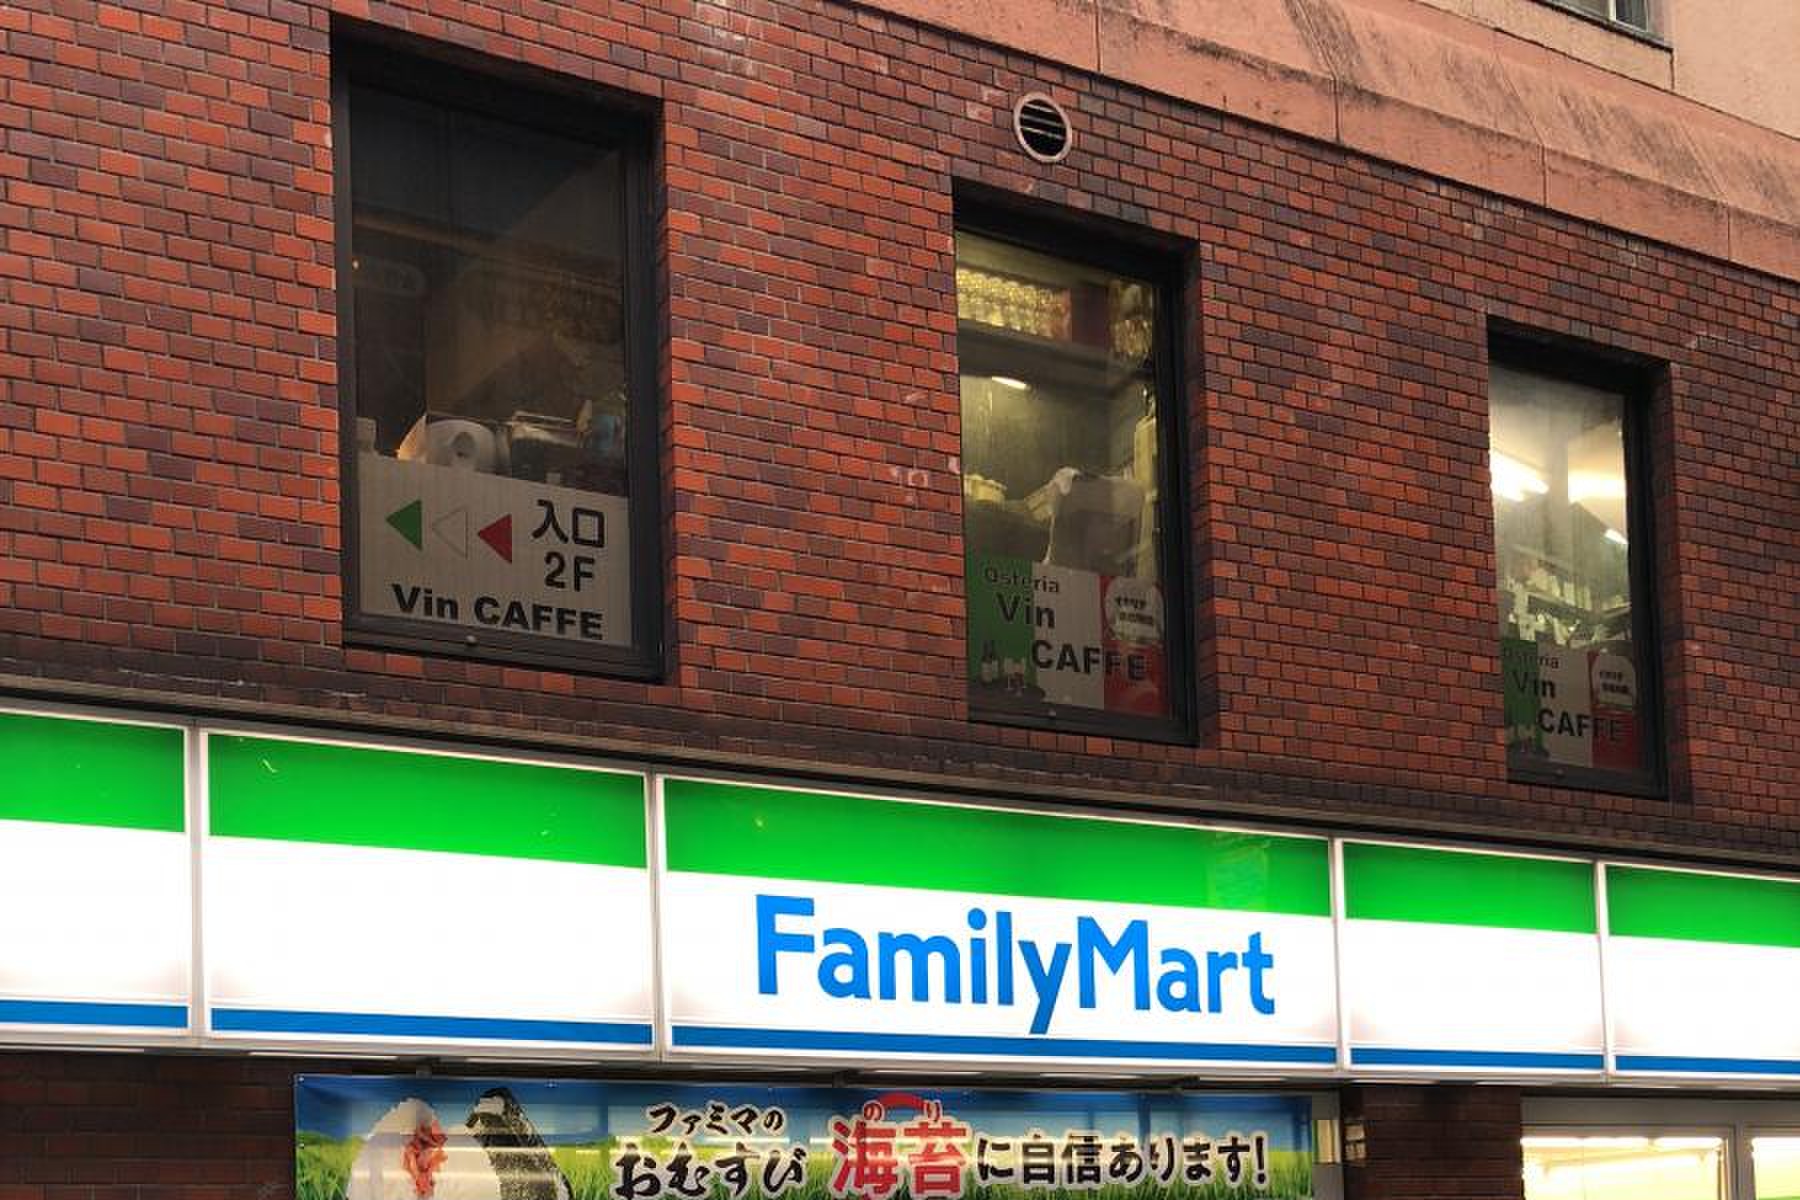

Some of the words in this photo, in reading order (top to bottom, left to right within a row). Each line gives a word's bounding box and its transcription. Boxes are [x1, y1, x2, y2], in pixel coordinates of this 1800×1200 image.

[532, 499, 605, 549] 入口
[544, 551, 596, 592] 2F
[391, 583, 459, 620] Vin
[473, 596, 603, 641] CAFFE
[995, 593, 1056, 629] Vin
[1031, 639, 1146, 682] CAFFE
[756, 893, 1275, 1035] FamilyMart
[648, 1103, 785, 1135] ファミマの
[613, 1142, 807, 1200] おむすび
